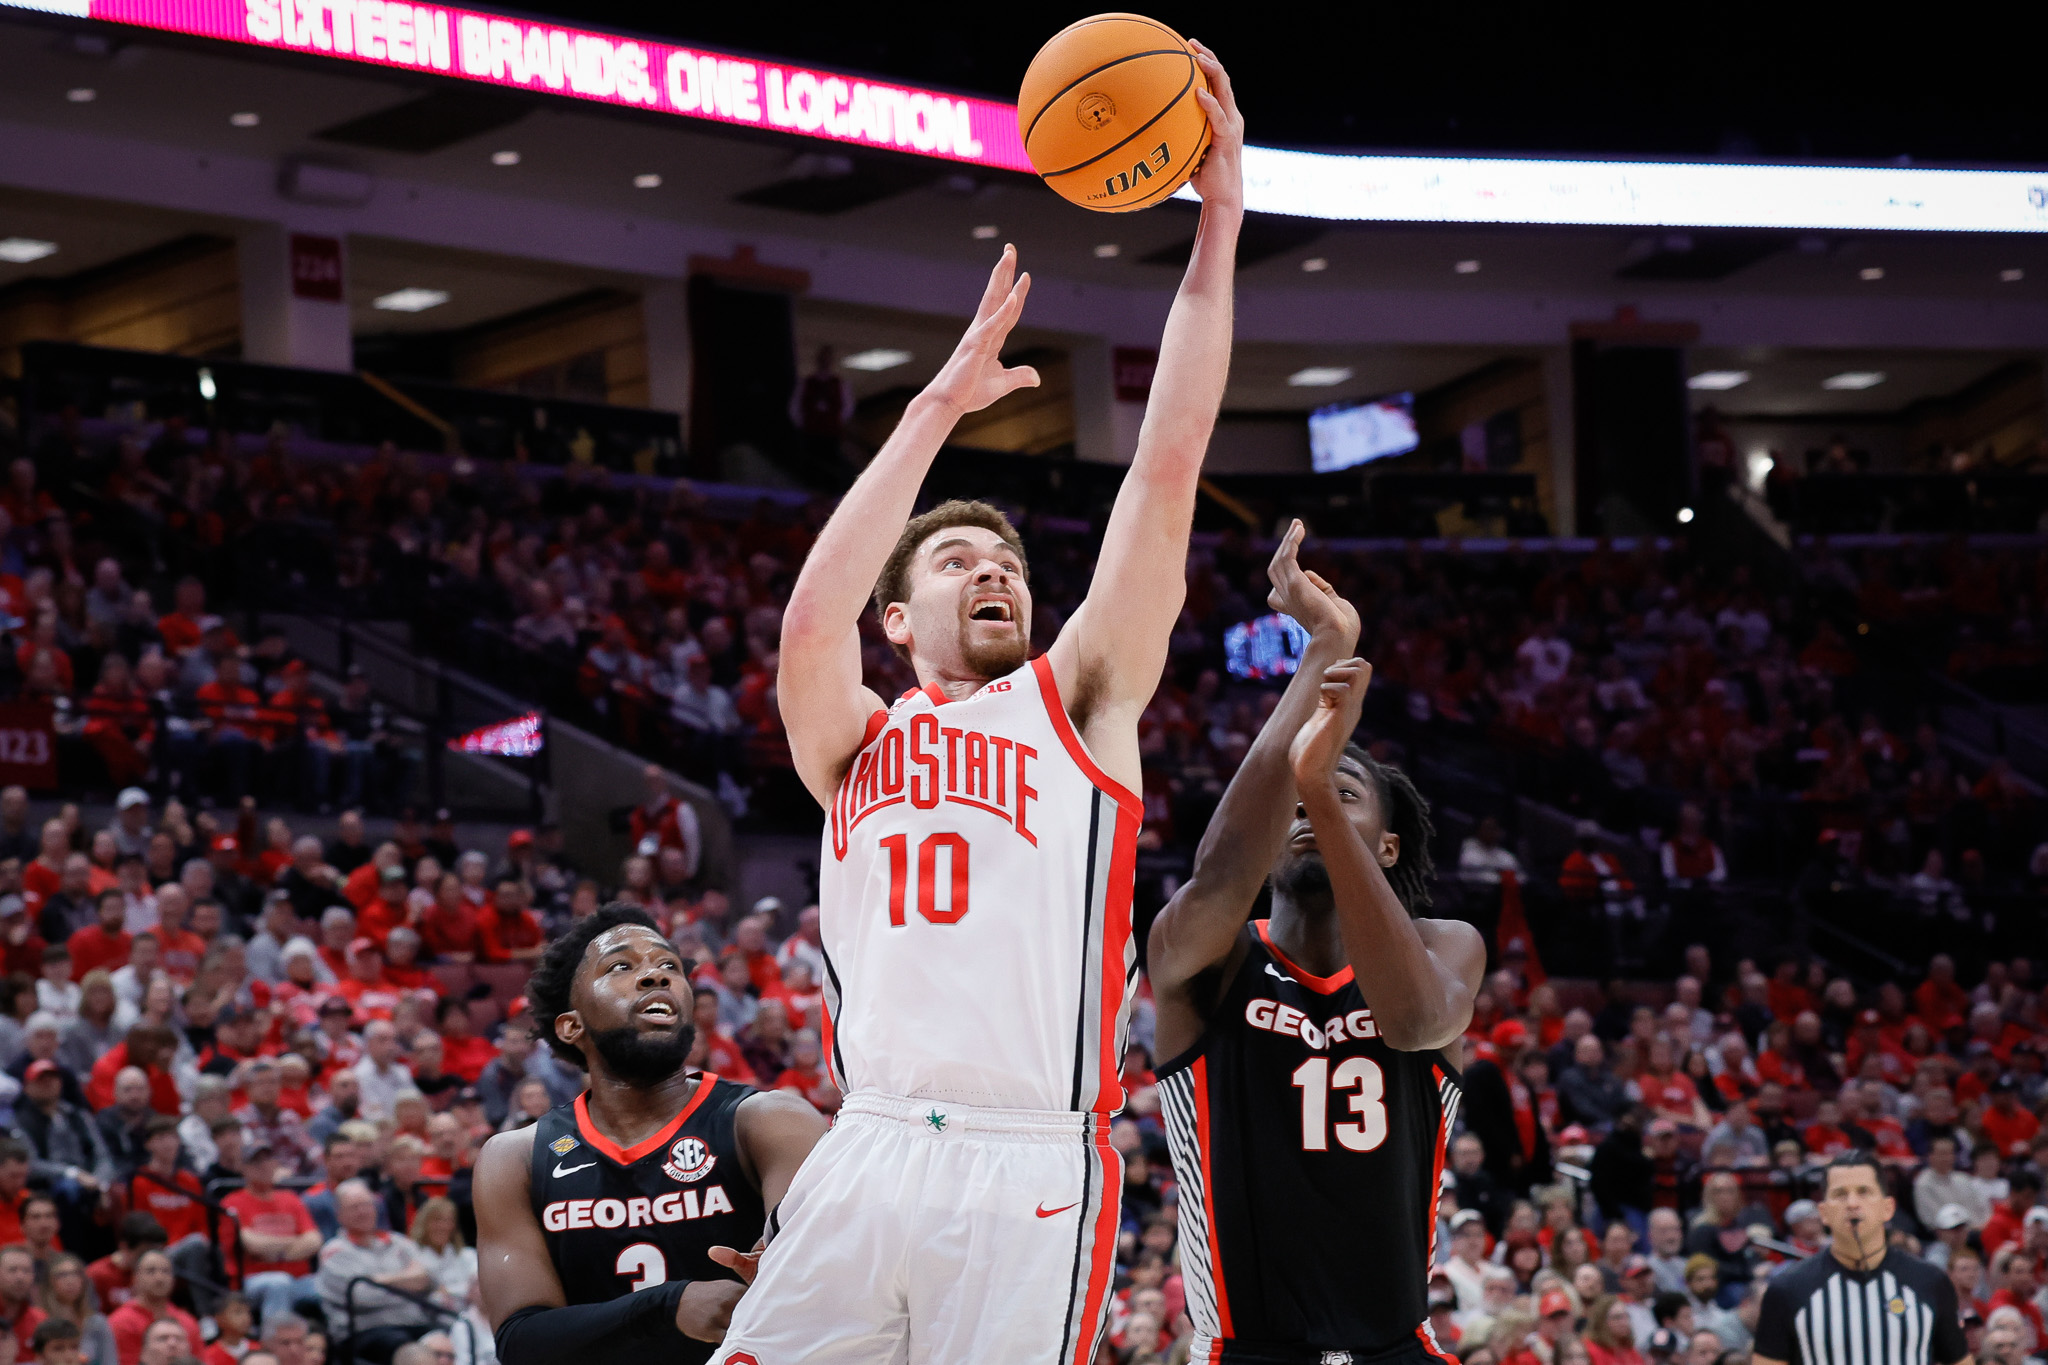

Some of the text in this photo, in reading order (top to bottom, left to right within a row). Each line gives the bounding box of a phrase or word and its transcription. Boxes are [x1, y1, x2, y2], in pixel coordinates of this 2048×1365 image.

[247, 0, 451, 70] SIXTEEN
[461, 15, 658, 105] BRANDS.
[667, 50, 762, 122] ONE
[765, 67, 984, 158] LOCATION.
[1104, 141, 1171, 196] EVO
[879, 832, 970, 928] 10
[1245, 998, 1383, 1050] GEORG
[1291, 1056, 1389, 1152] 13
[671, 1138, 706, 1170] SEC
[543, 1184, 735, 1232] GEORGIA
